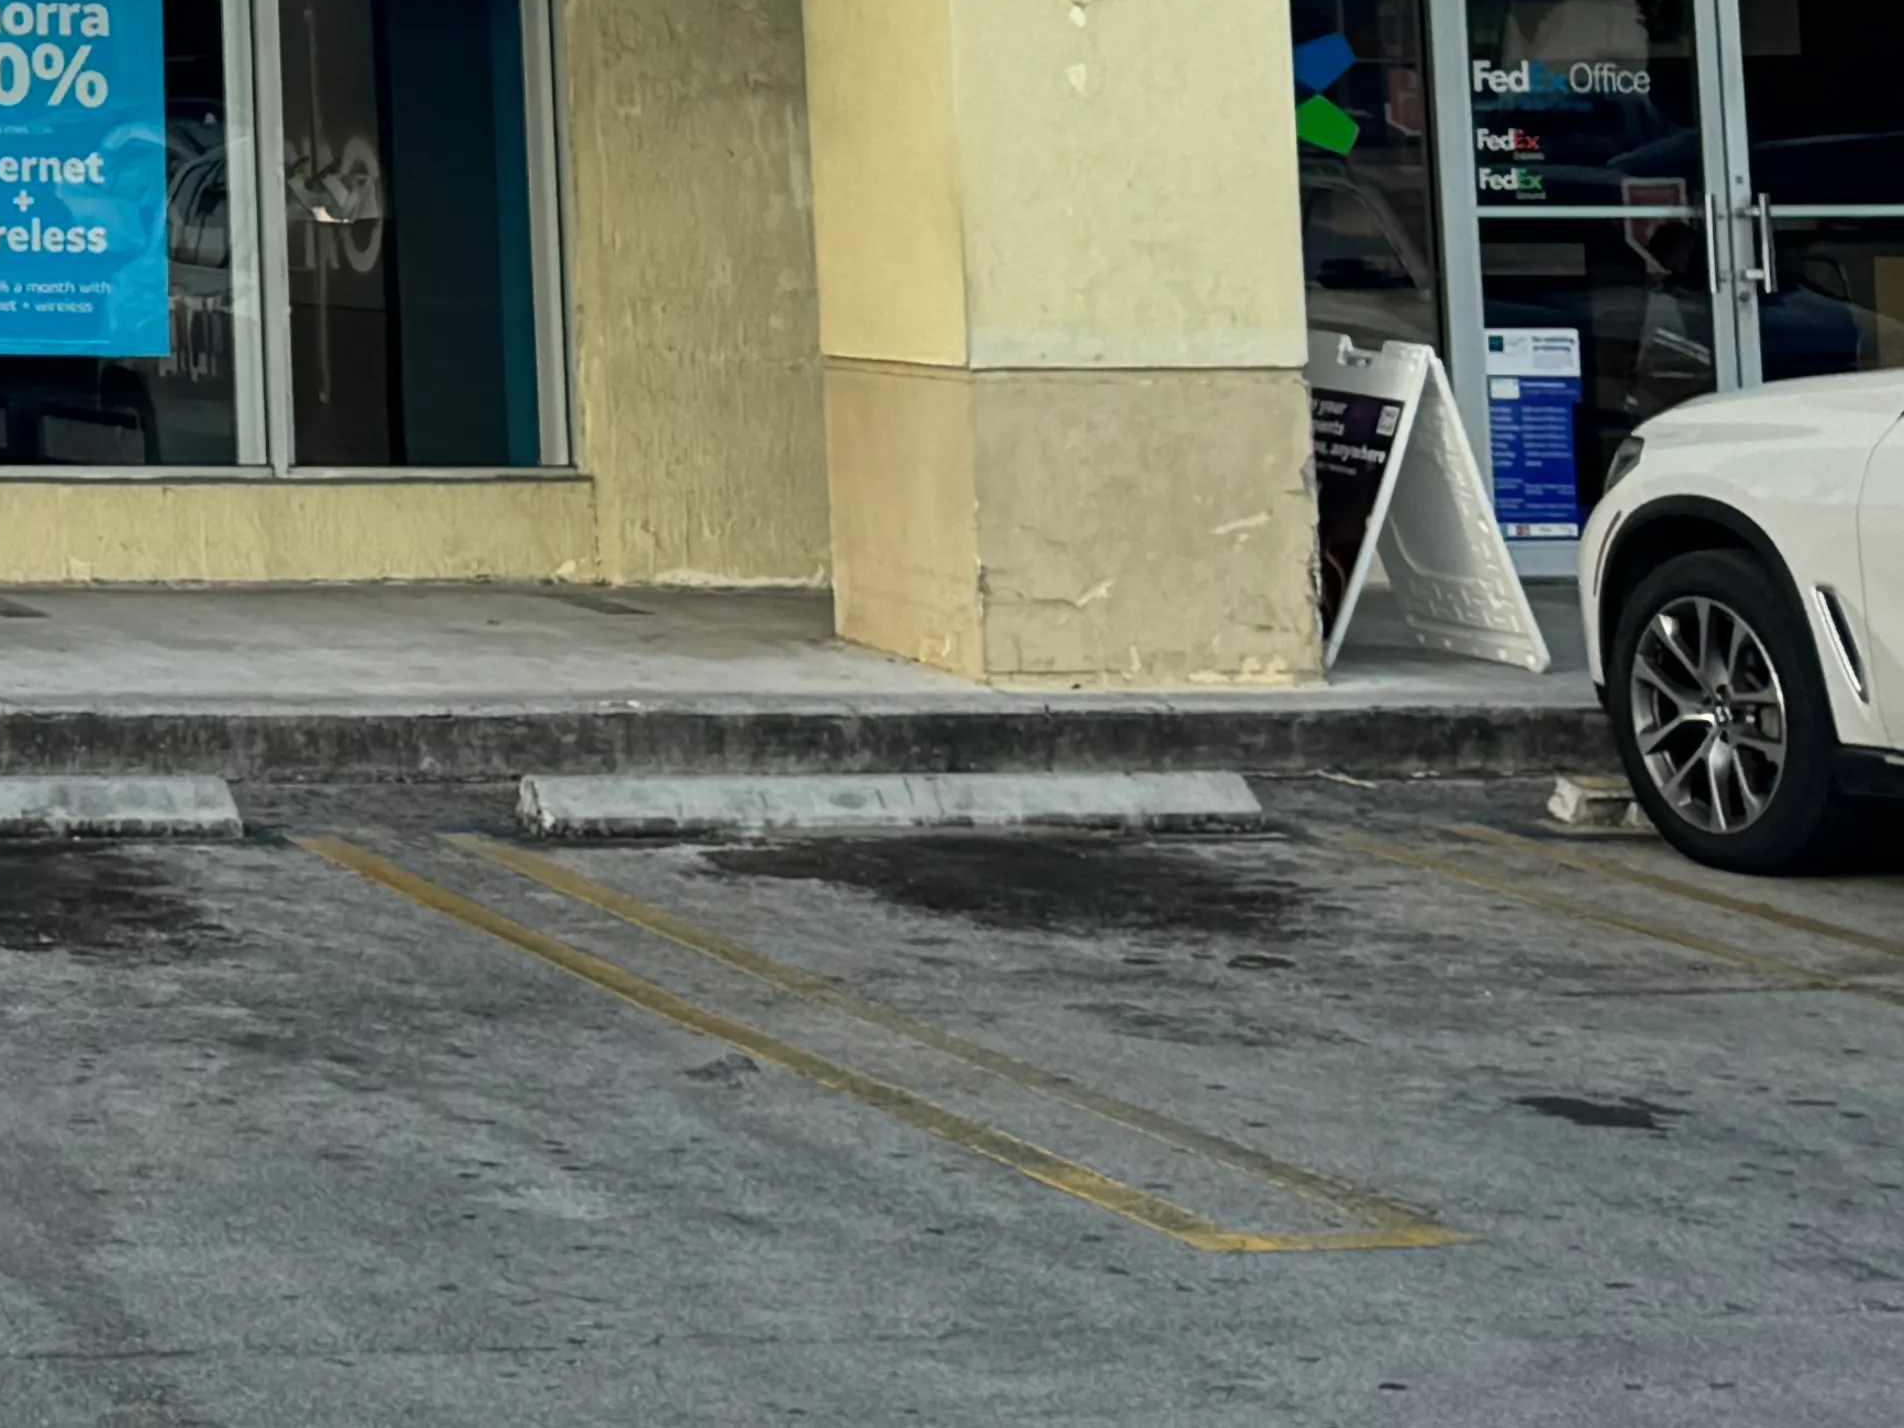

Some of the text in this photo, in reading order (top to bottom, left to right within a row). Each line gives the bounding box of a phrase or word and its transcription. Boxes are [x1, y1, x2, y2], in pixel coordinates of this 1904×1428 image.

[1472, 60, 1651, 95] FedEx Office
[1476, 128, 1540, 151] FedEx
[1478, 167, 1543, 190] FedEx
[26, 281, 75, 293] month
[79, 281, 111, 294] with
